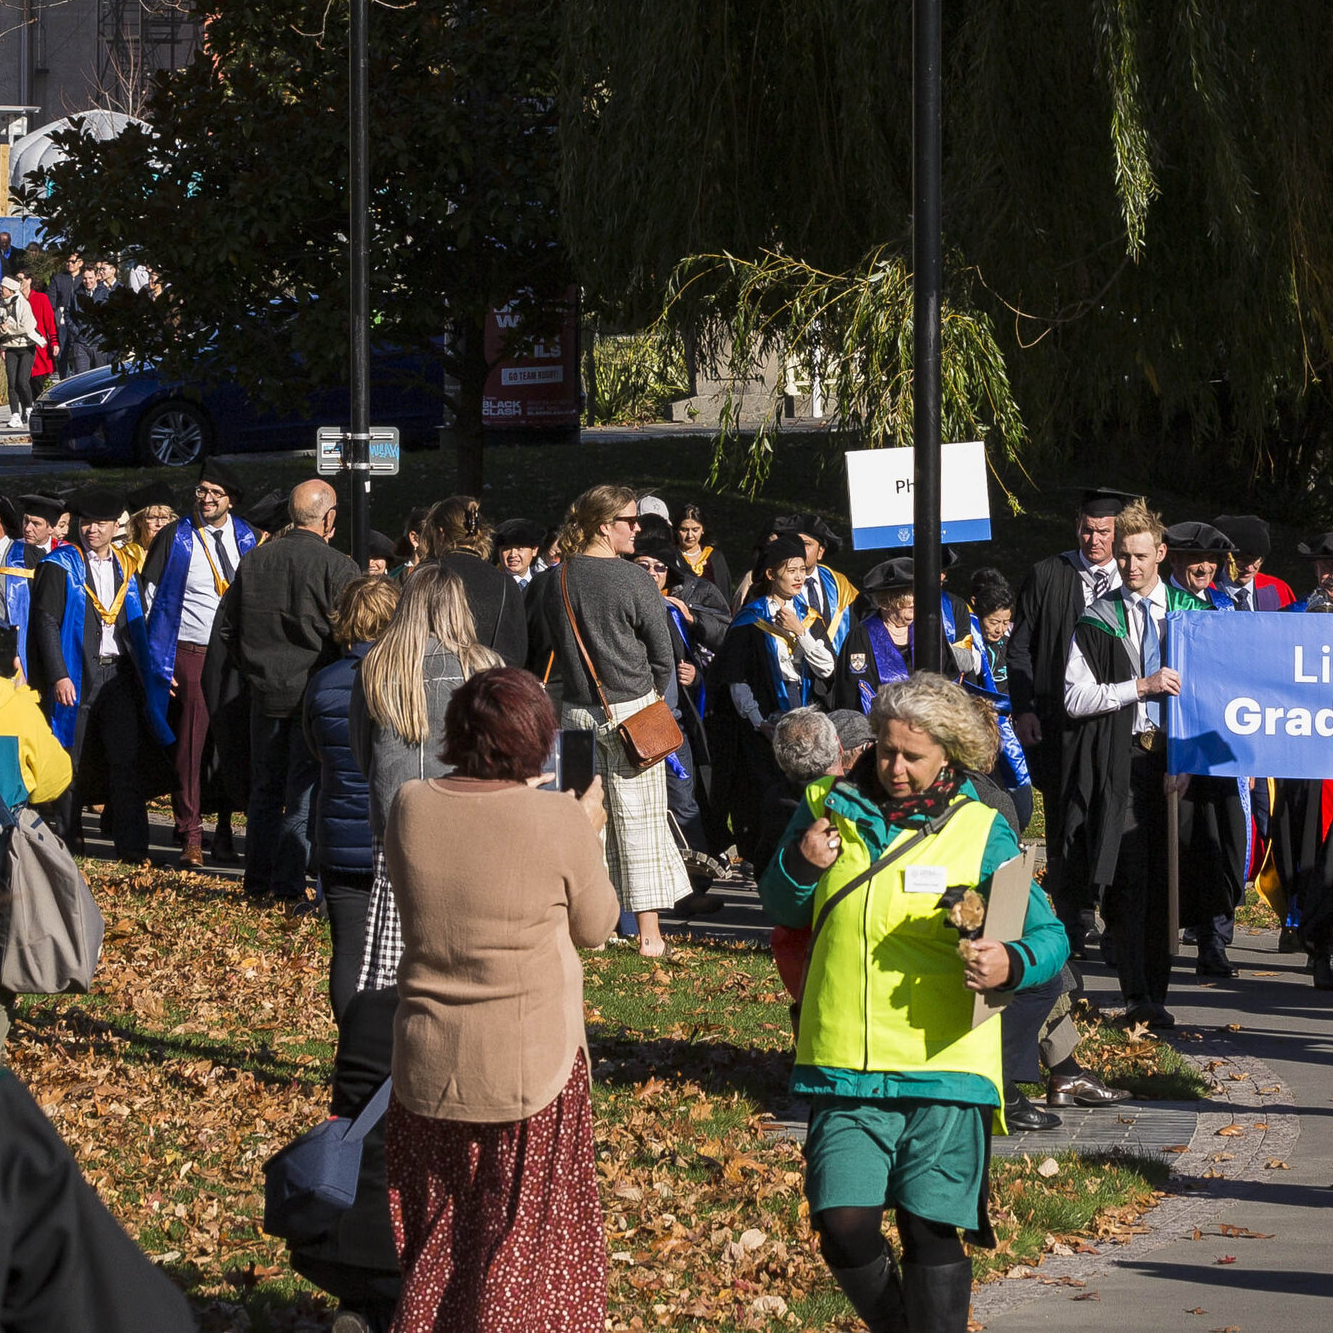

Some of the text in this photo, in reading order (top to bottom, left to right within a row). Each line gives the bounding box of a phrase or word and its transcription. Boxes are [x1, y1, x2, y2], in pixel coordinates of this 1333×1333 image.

[508, 371, 518, 381] GO
[519, 370, 536, 381] TEAM
[482, 400, 521, 408] BLACK
[482, 408, 522, 417] CLASH
